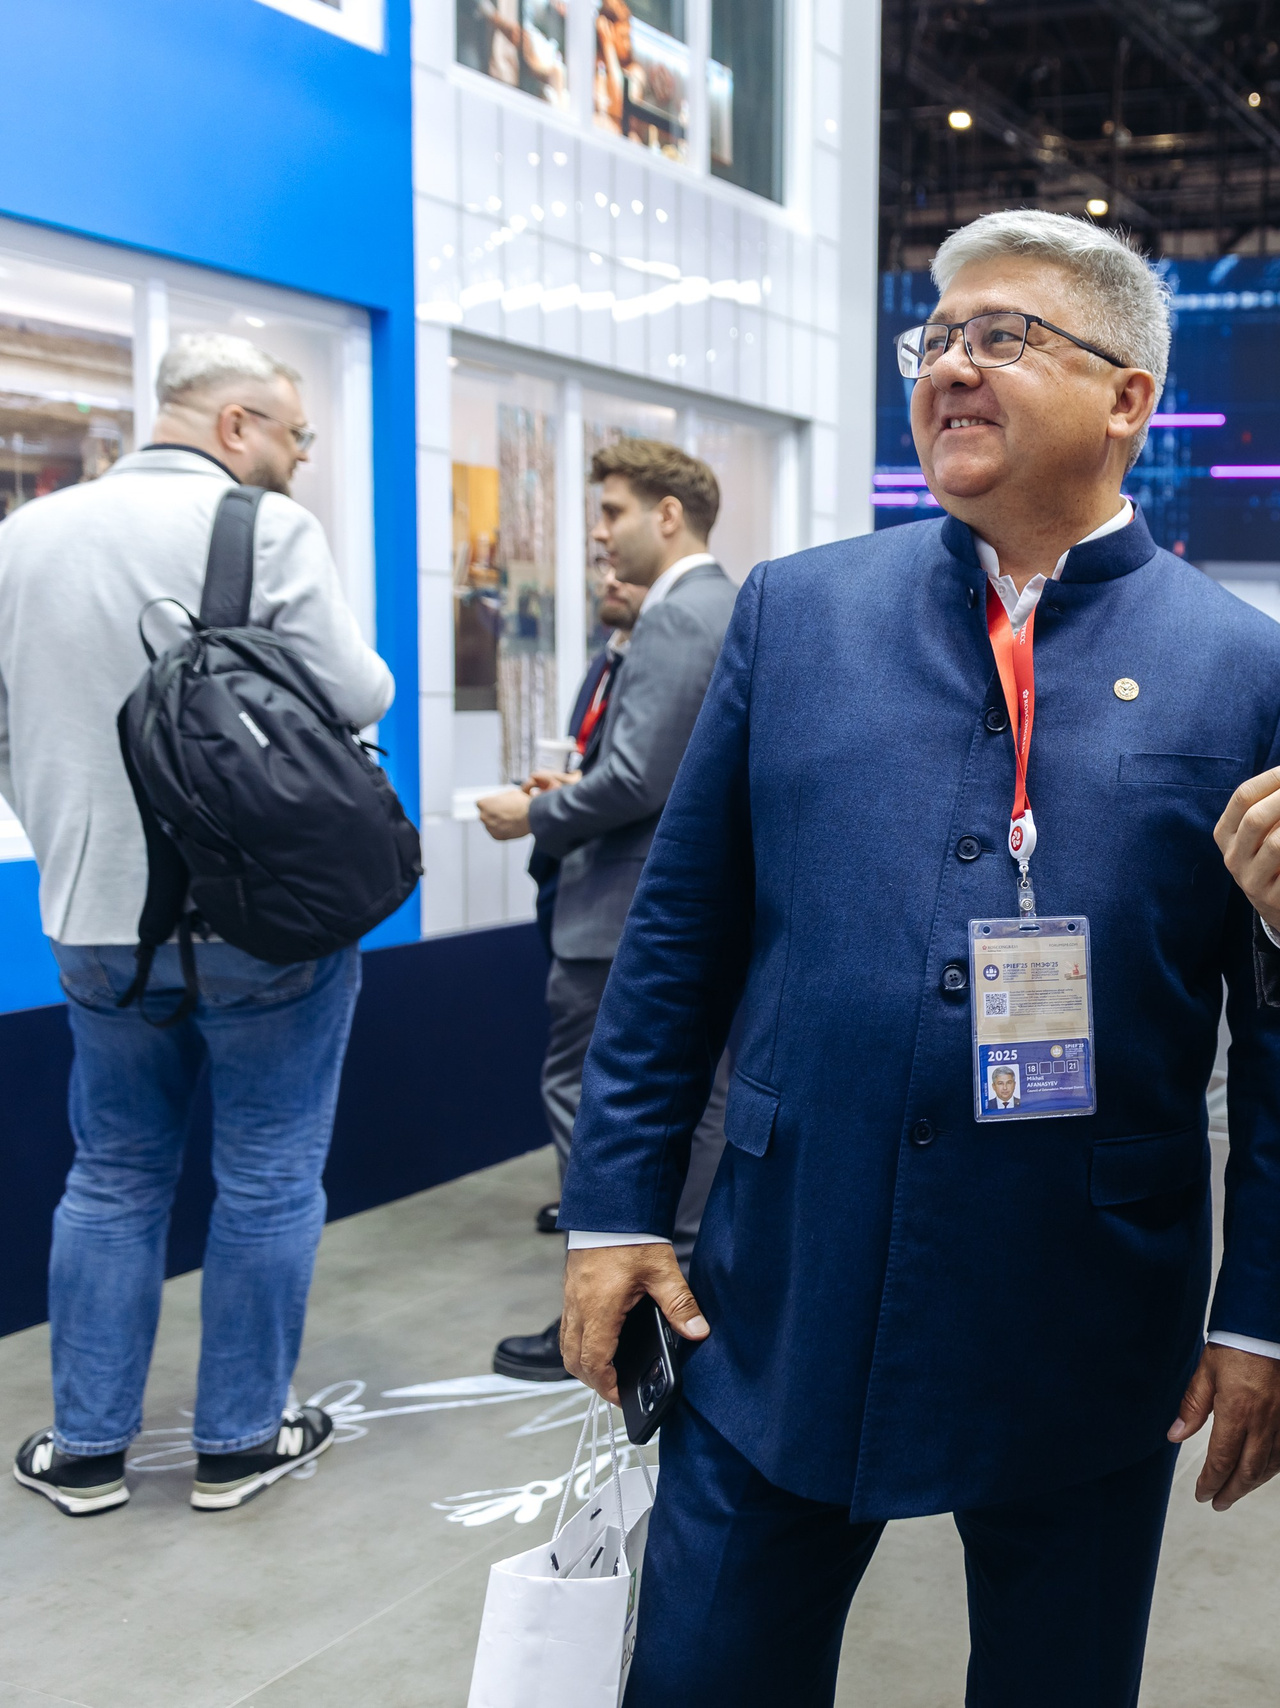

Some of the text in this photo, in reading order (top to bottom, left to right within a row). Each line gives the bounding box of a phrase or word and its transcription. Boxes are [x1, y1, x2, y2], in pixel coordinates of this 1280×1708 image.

[987, 1049, 1018, 1062] 2025
[1027, 1065, 1036, 1073] 18
[1068, 1062, 1077, 1070] 21
[276, 1426, 303, 1456] N
[31, 1442, 53, 1474] N
